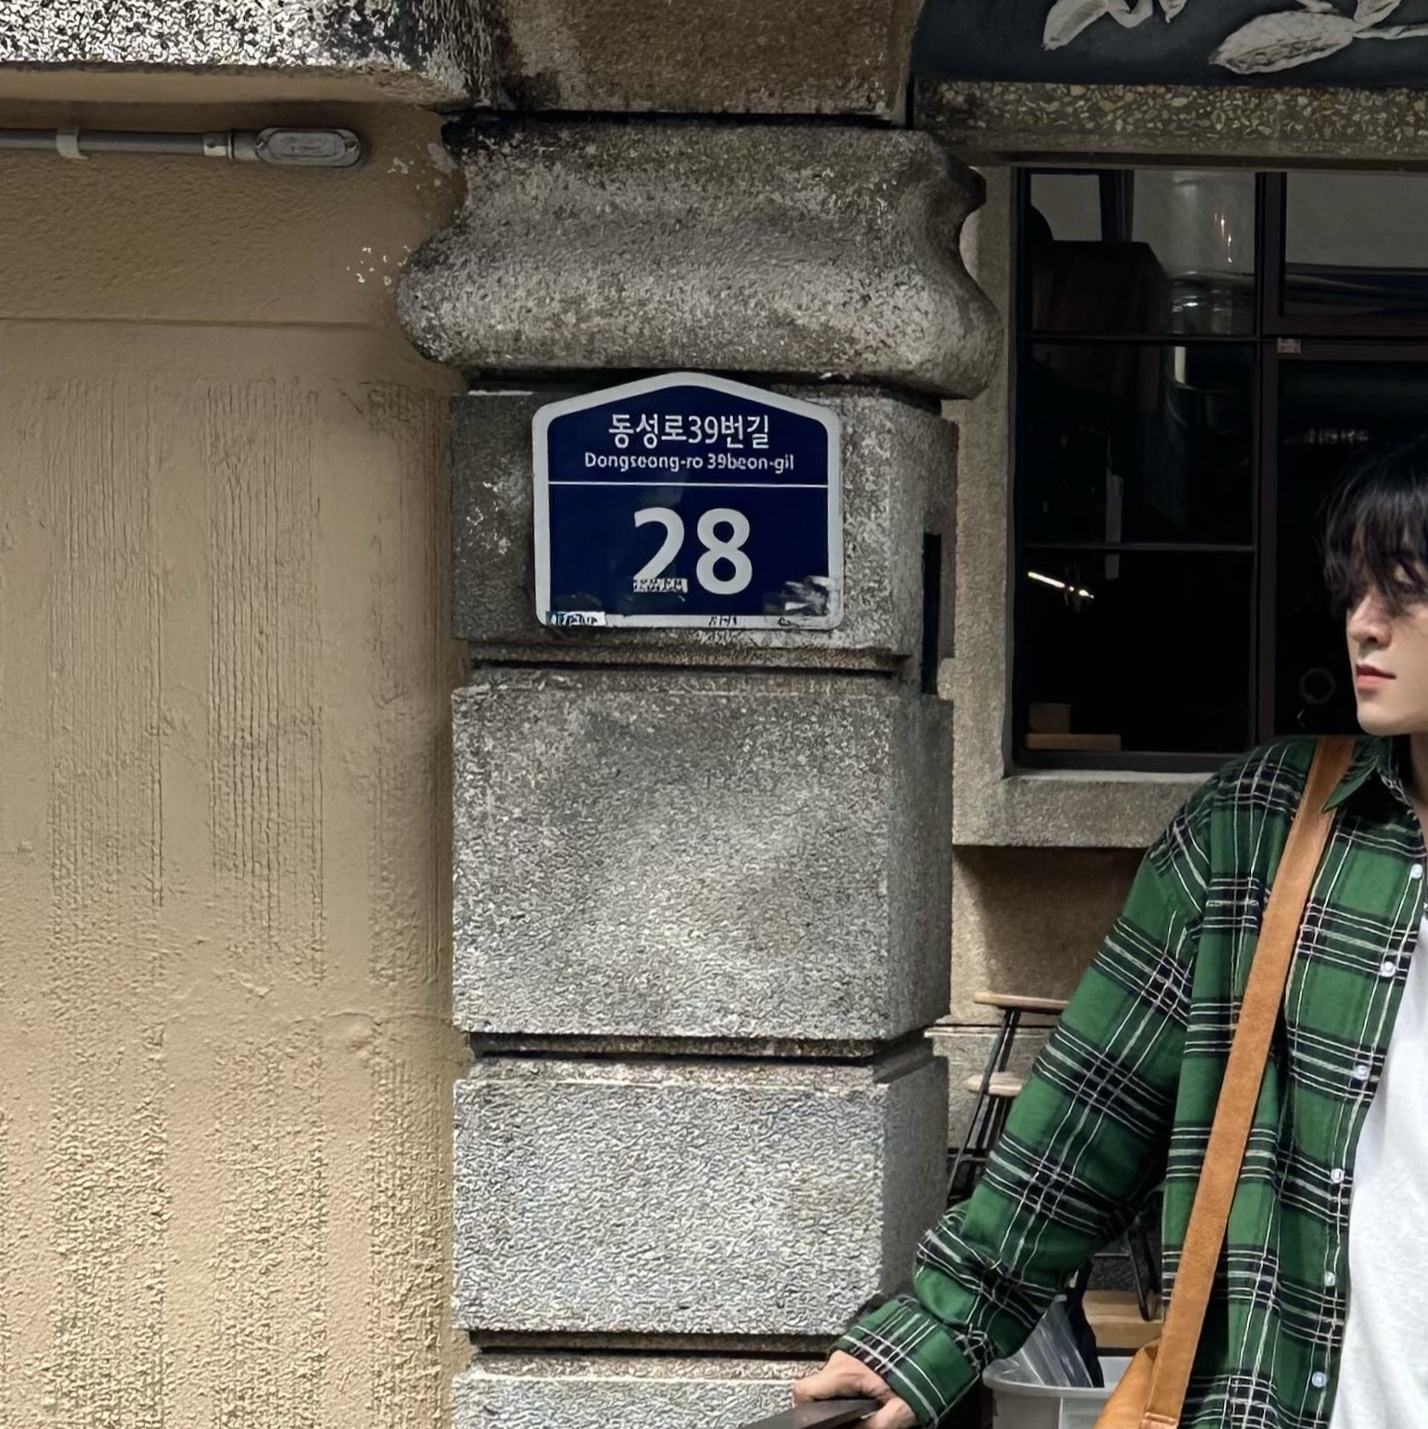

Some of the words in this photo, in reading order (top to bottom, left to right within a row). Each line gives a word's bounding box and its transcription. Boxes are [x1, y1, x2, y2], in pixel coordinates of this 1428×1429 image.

[608, 413, 770, 449] 동성로39번길
[584, 452, 703, 473] Dongseong-ro
[707, 453, 795, 474] 39beon-gil
[633, 507, 753, 595] 28
